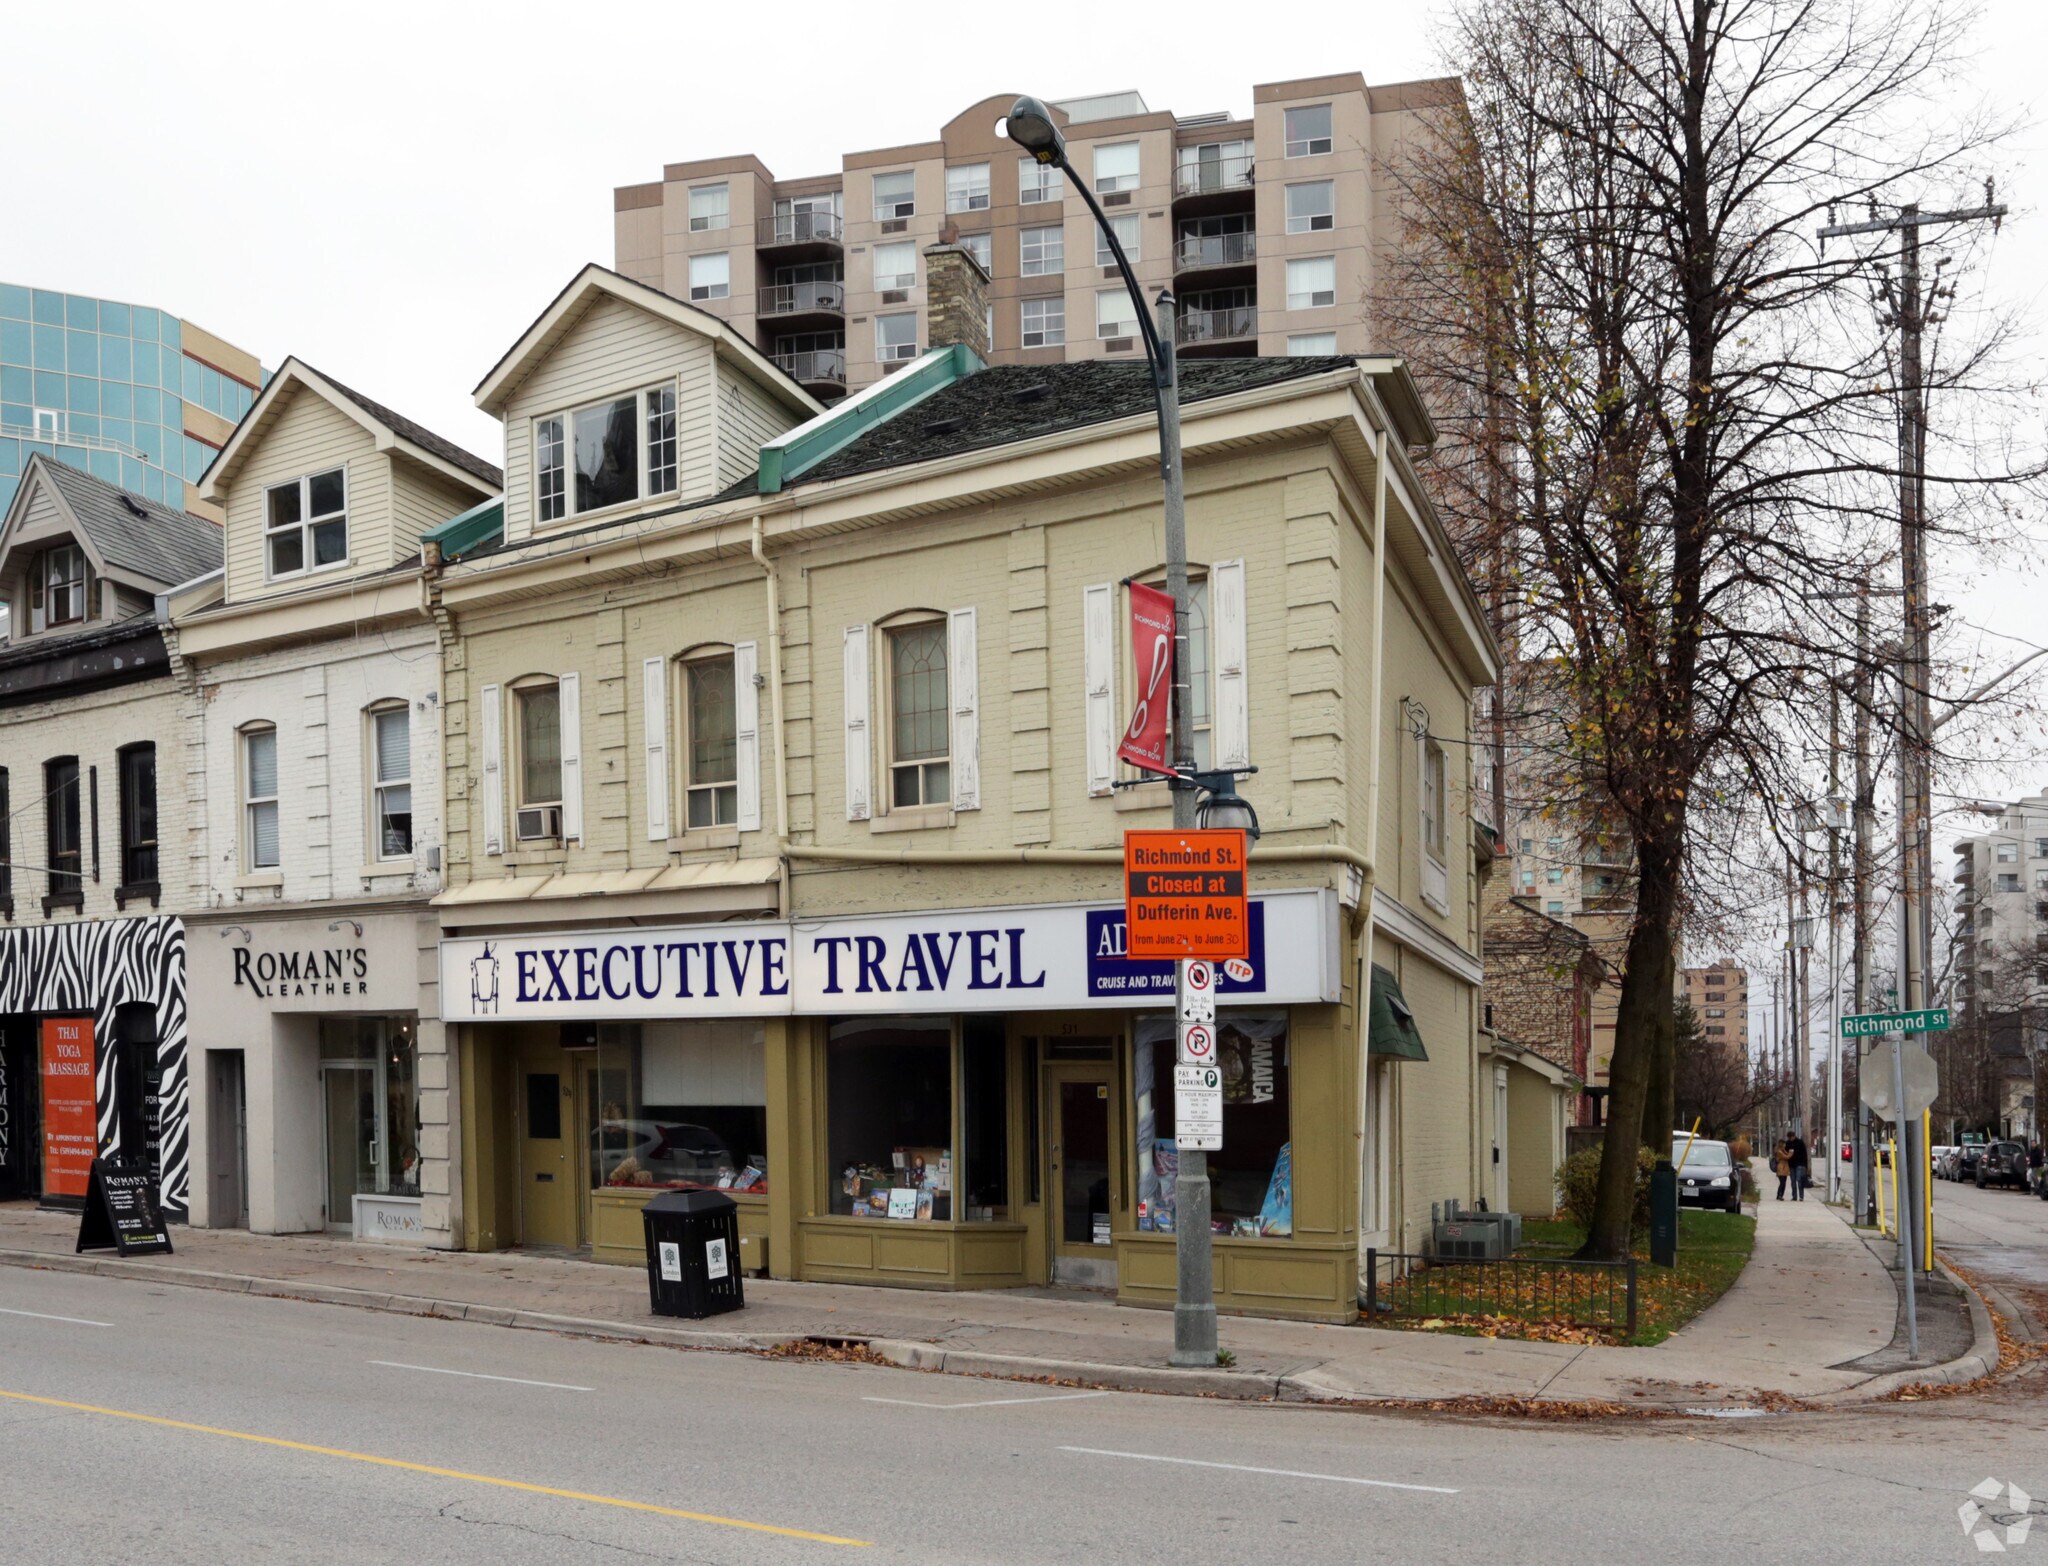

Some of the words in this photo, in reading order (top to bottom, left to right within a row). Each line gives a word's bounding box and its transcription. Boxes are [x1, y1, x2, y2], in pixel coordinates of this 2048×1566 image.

[1134, 613, 1161, 630] RICHMOND
[1147, 748, 1161, 762] ROW
[1135, 848, 1211, 865] Richmond
[1216, 848, 1237, 864] St.
[1147, 875, 1204, 893] Closed
[1208, 876, 1227, 893] at
[1137, 904, 1200, 921] Dufferin
[1205, 904, 1238, 920] Ave.
[1135, 934, 1154, 945] from
[1156, 934, 1175, 945] June
[1195, 934, 1203, 945] to
[1205, 934, 1224, 945] June
[1226, 933, 1240, 945] 30
[232, 947, 367, 998] ROMAN'S
[515, 938, 790, 1003] EXECUTIVE
[813, 928, 1046, 994] TRAVEL
[1229, 962, 1253, 978] ITP
[266, 981, 367, 997] LEATHER
[1097, 976, 1126, 990] CRUISE
[1128, 975, 1148, 988] AND
[1844, 1014, 1926, 1034] Richmond
[1932, 1013, 1945, 1025] St
[57, 1026, 79, 1040] THAI
[56, 1044, 81, 1058] YOGA
[48, 1062, 90, 1076] MASSAGE
[1178, 1079, 1205, 1087] PARKING
[145, 1096, 158, 1105] FOR
[105, 1176, 148, 1186] ROMAN'S
